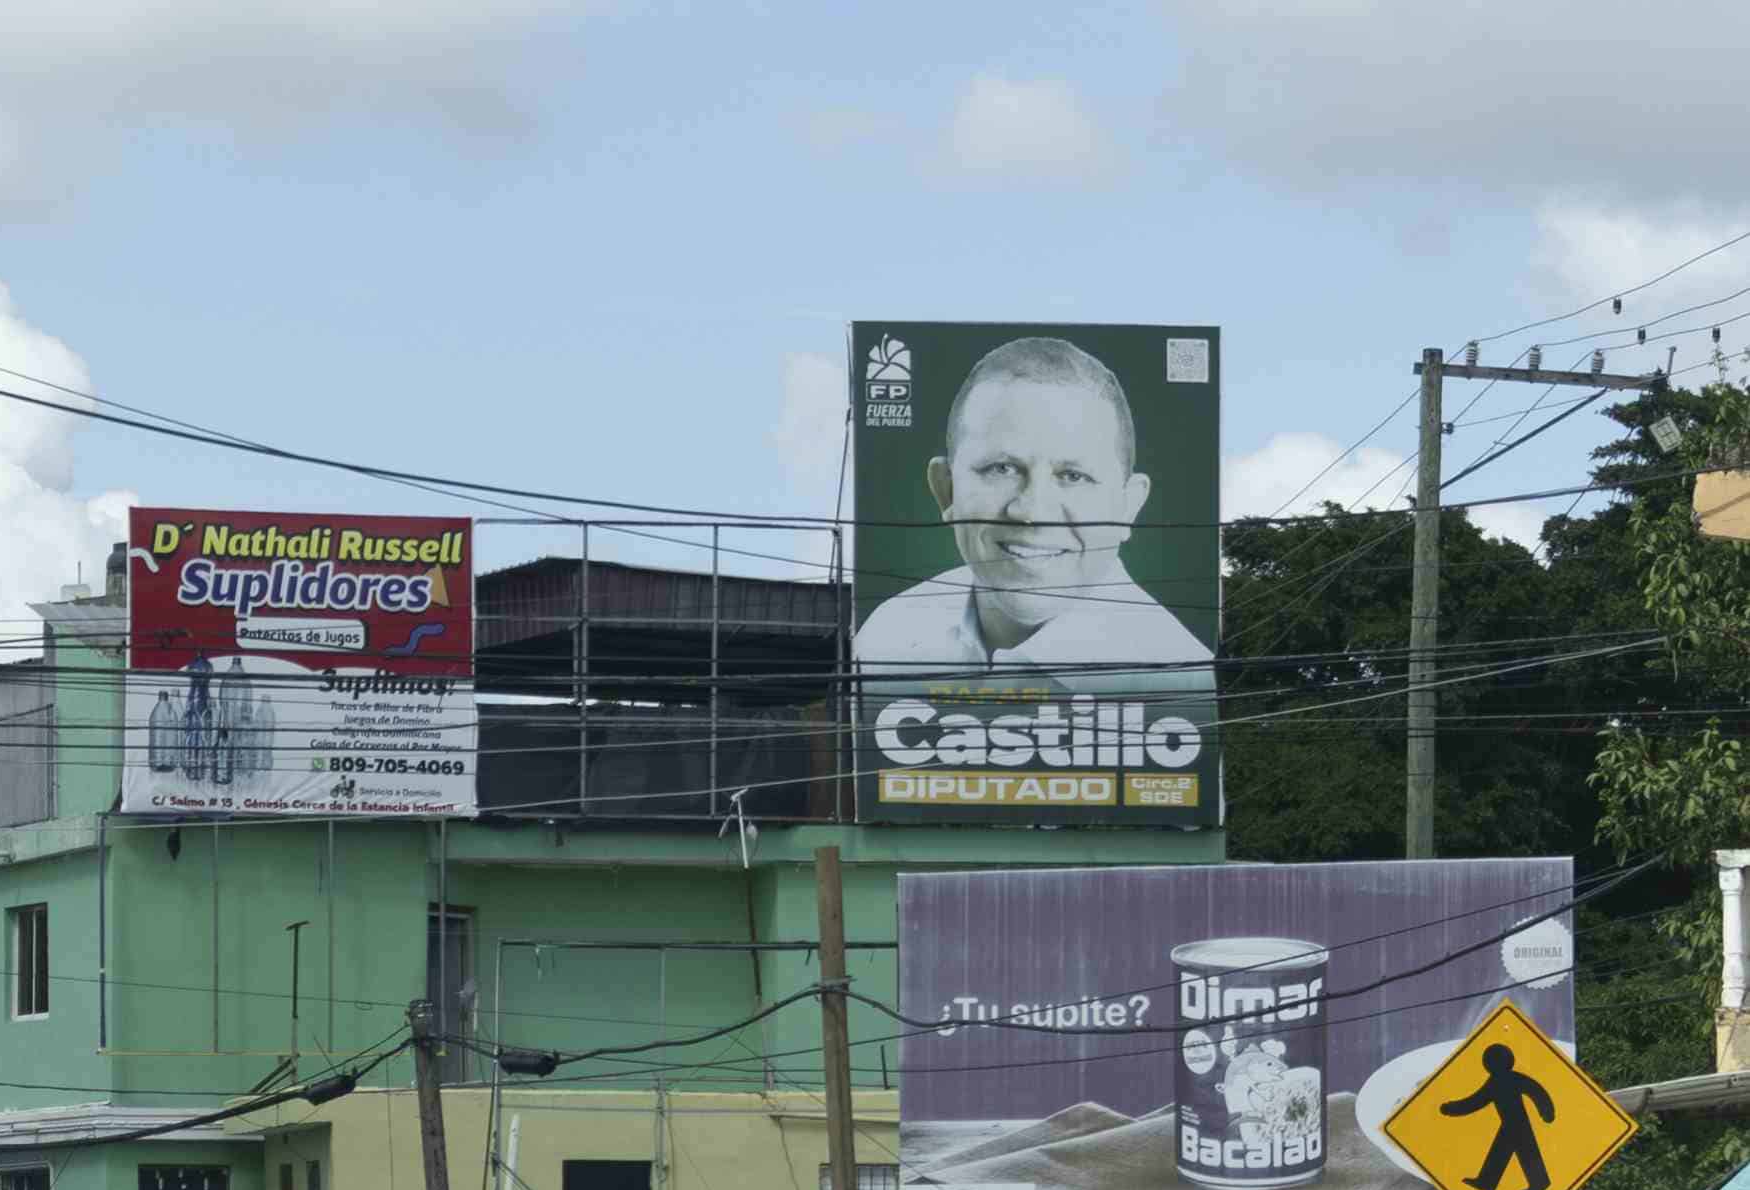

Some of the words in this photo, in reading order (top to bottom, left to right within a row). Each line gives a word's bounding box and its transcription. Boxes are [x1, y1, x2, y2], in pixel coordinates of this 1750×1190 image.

[870, 385, 907, 399] FP
[866, 404, 911, 417] FUERZA
[202, 526, 332, 560] Nathali
[338, 530, 463, 565] Russell
[178, 558, 433, 618] Suplidores
[306, 630, 320, 642] de
[325, 630, 361, 647] Jugos
[359, 702, 371, 711] de
[402, 704, 414, 712] de
[377, 716, 390, 725] de
[874, 694, 1201, 768] Castillo
[340, 740, 350, 750] de
[330, 757, 464, 775] 809-705-4069
[884, 775, 1112, 801] DIPUTADO
[1131, 777, 1191, 789] Circ.2
[152, 796, 166, 806] C/
[292, 799, 325, 809] Cerca
[329, 800, 343, 810] de
[361, 802, 409, 812] Estancia
[1514, 946, 1562, 959] ORIGINAL
[1181, 971, 1322, 1024] Dimar
[938, 996, 999, 1036] ¿Tu
[1010, 994, 1151, 1032] supite?
[1181, 1123, 1322, 1168] Bacalao
